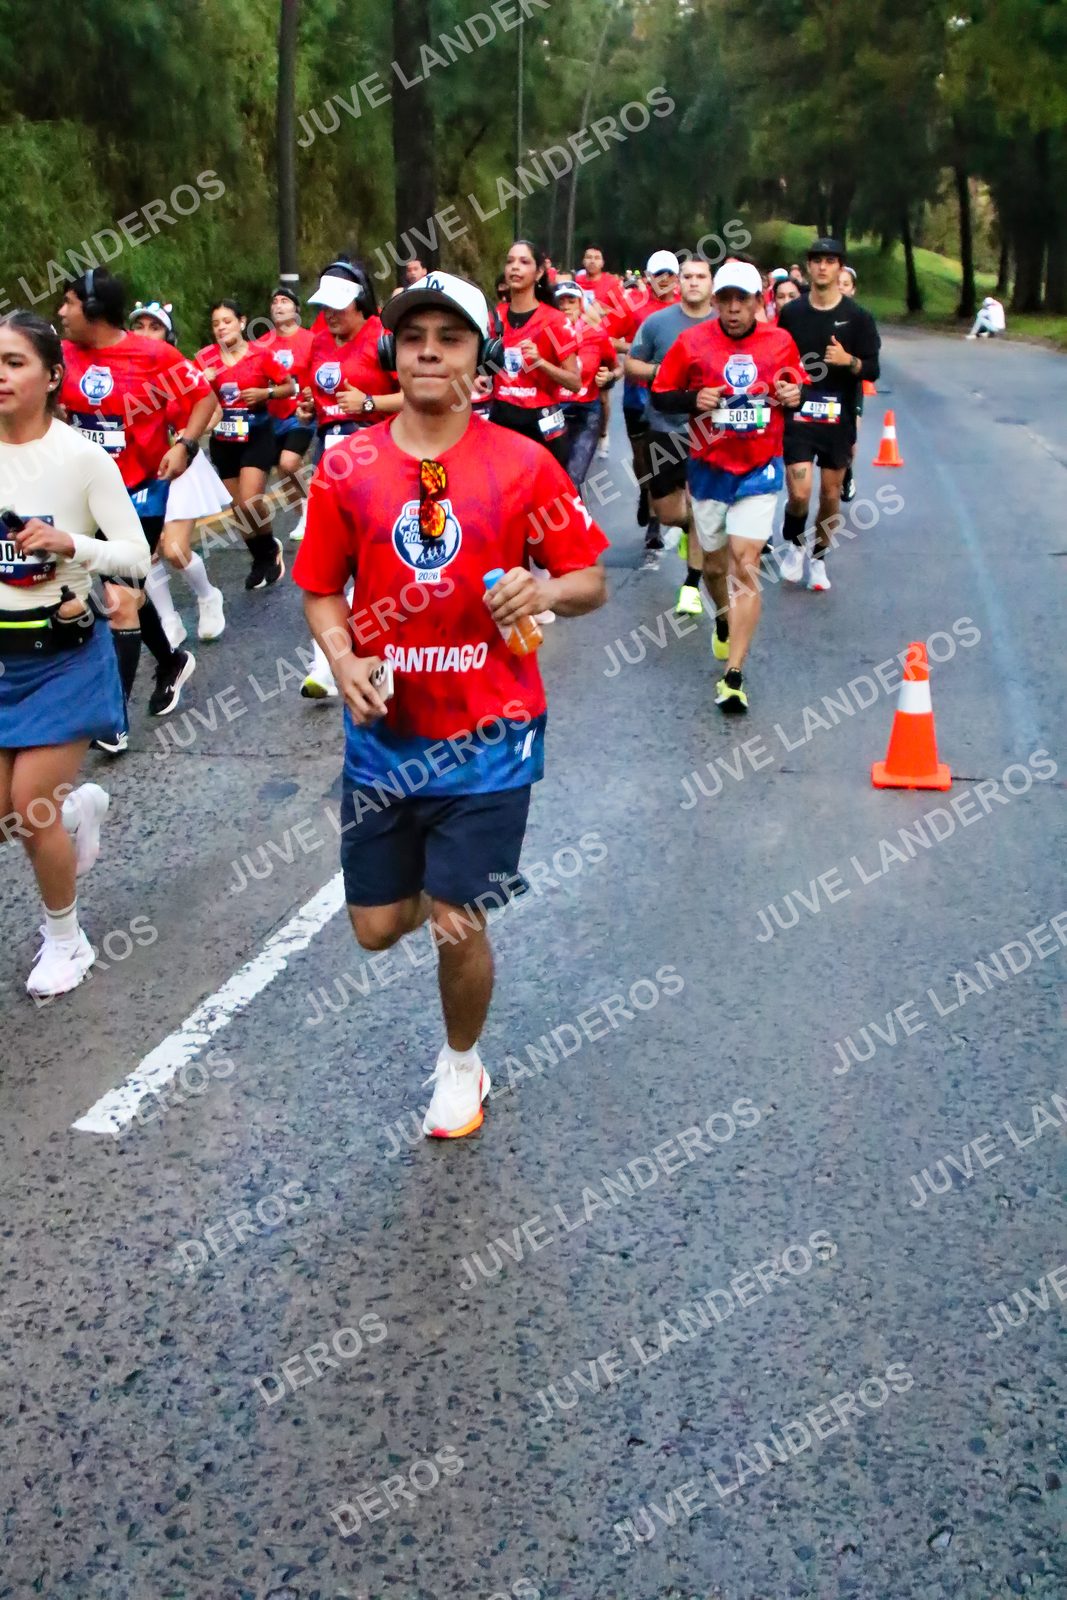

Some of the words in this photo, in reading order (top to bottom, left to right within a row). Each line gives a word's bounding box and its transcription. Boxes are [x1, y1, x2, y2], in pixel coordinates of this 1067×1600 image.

[729, 410, 756, 423] 5034
[417, 572, 439, 581] 2026
[383, 641, 488, 674] SANTIAGO
